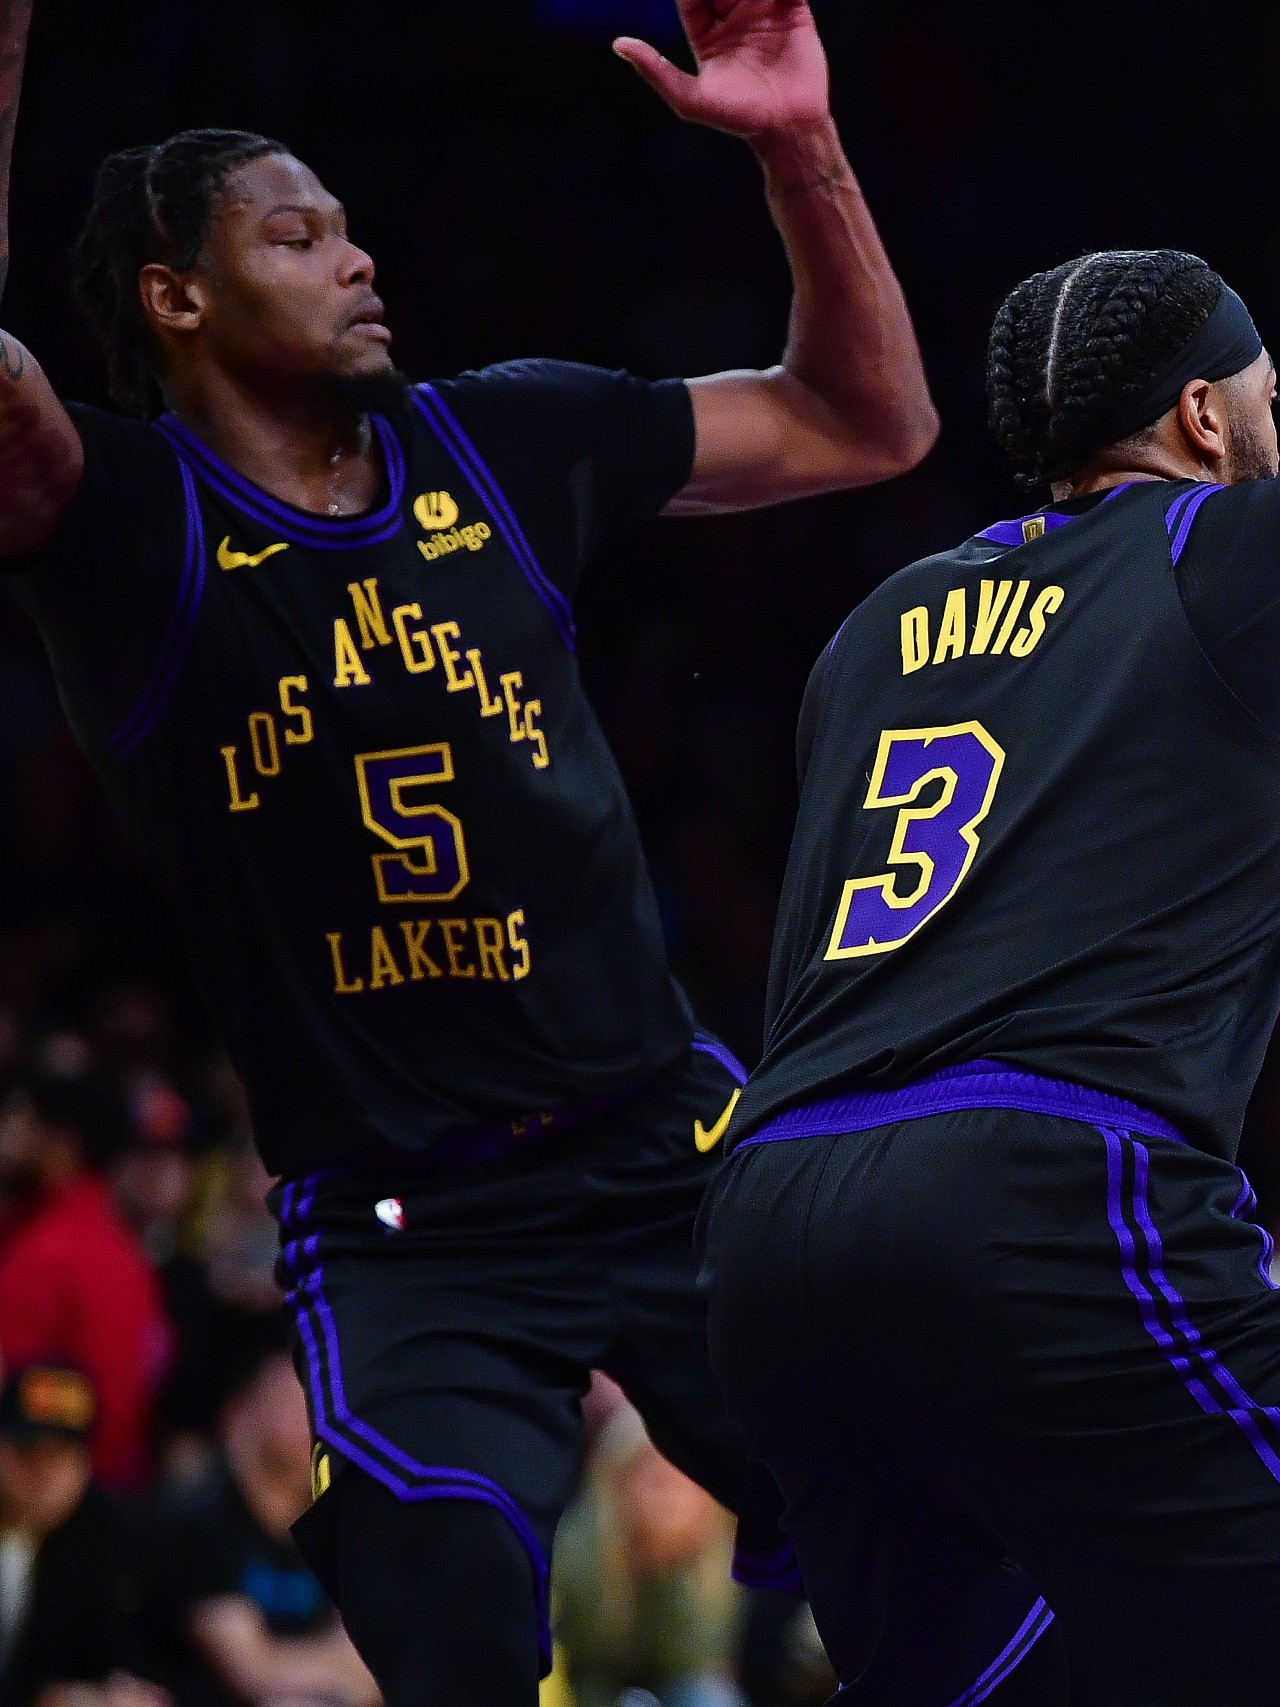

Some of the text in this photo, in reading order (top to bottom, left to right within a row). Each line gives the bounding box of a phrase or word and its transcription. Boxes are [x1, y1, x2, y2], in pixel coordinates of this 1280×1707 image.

[417, 522, 491, 561] bibigo
[901, 580, 1065, 676] DAVIS
[221, 578, 549, 812] LOS ANGELES
[354, 742, 470, 904] 5
[824, 720, 1006, 961] 3
[327, 909, 531, 993] LAKERS
